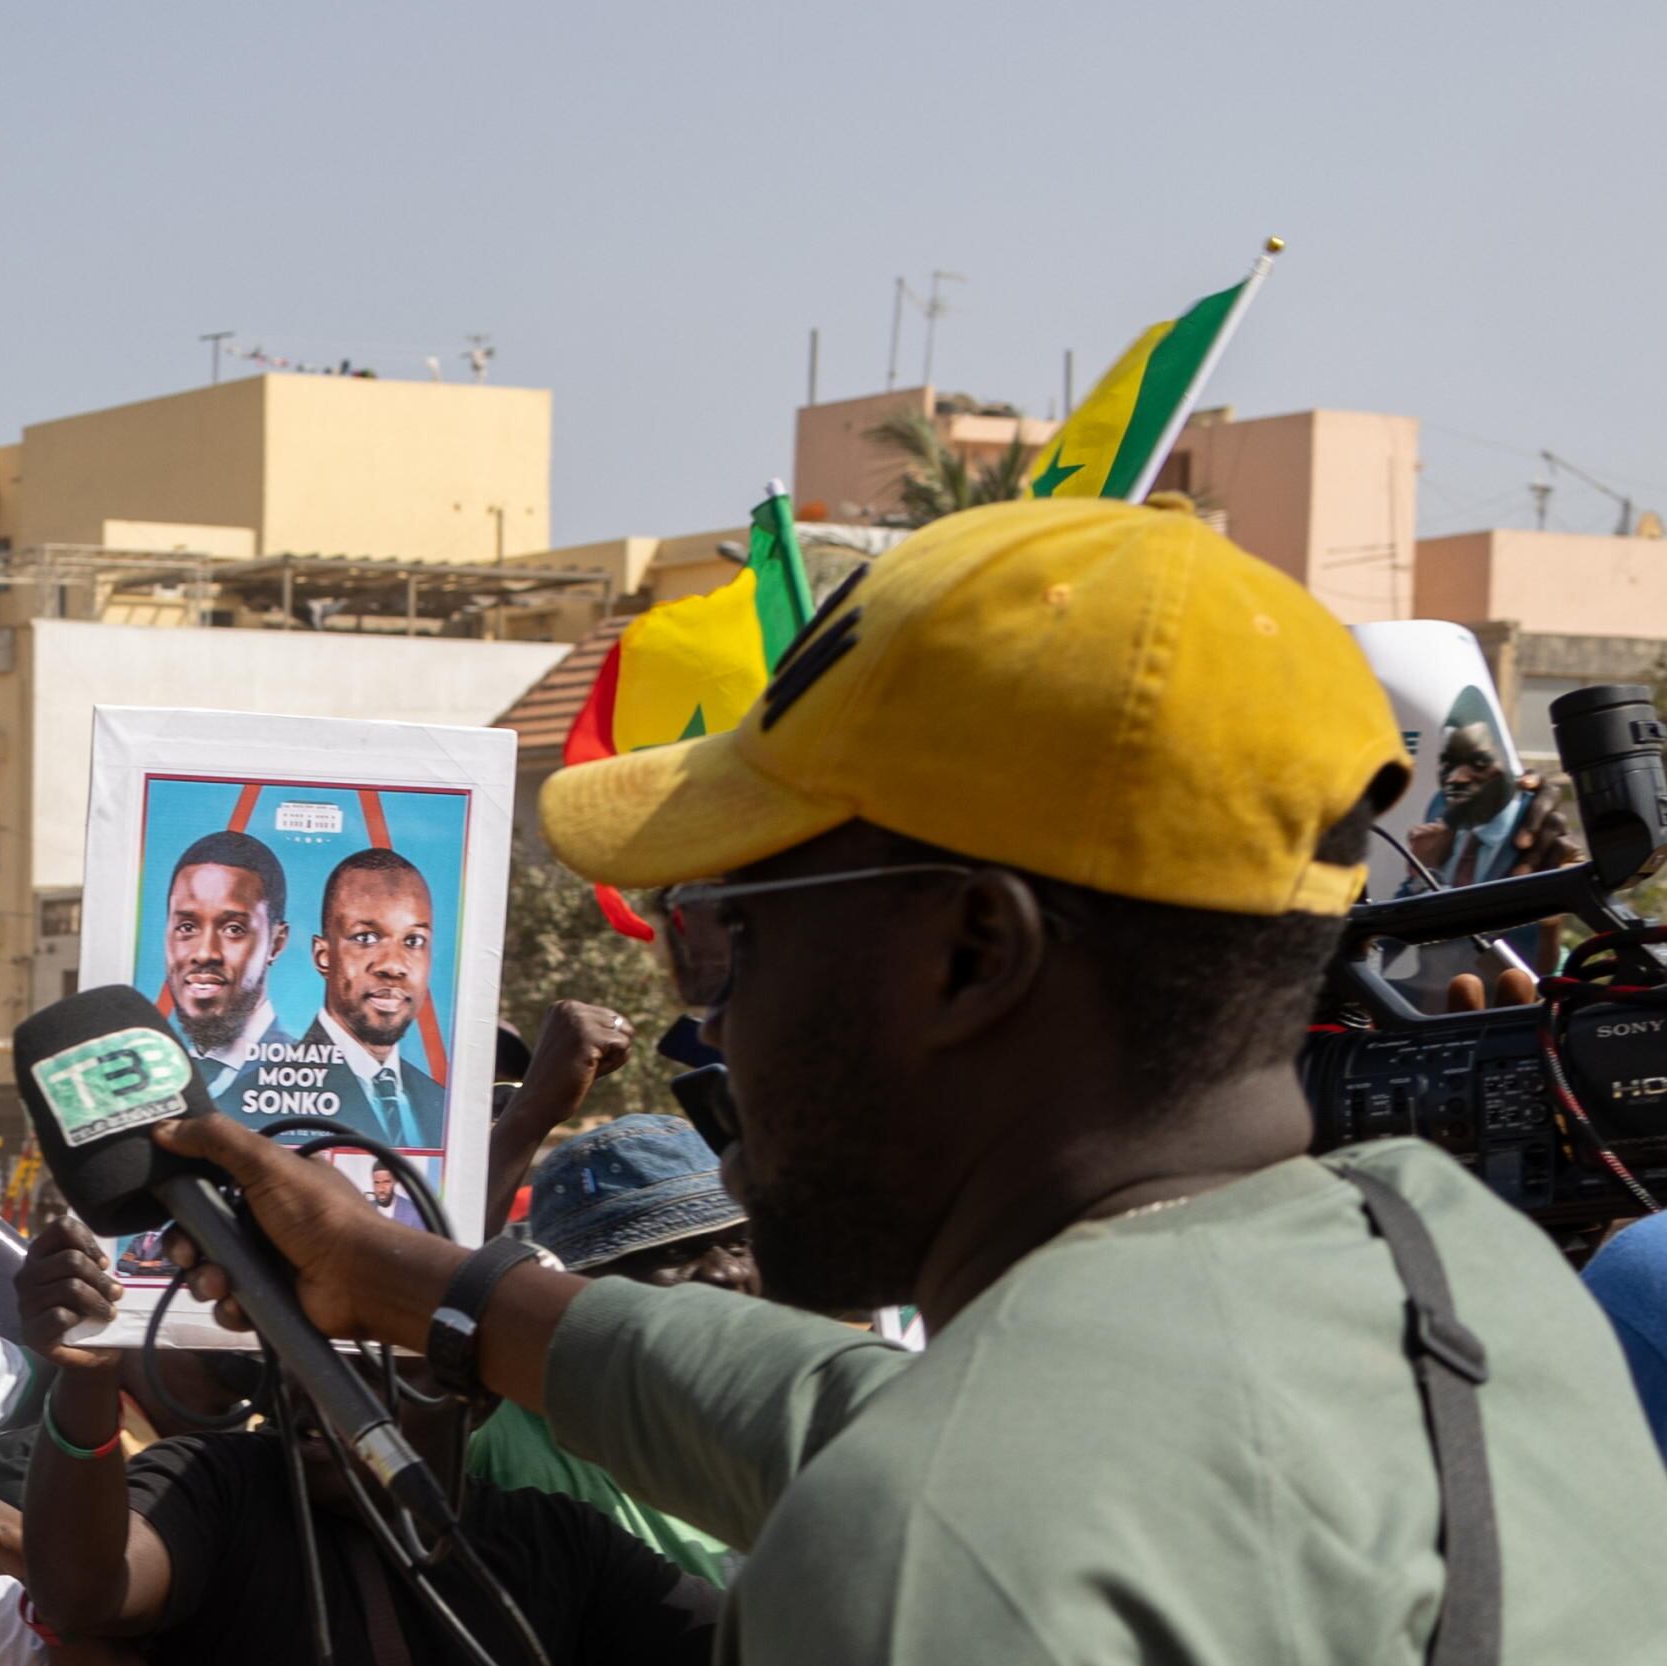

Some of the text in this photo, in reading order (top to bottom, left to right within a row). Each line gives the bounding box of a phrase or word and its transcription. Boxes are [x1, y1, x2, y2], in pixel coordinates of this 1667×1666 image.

[1596, 1019, 1665, 1038] SONY
[246, 1042, 345, 1065] DIOMAYE
[258, 1067, 329, 1088] MOOY
[241, 1089, 341, 1116] SONKO
